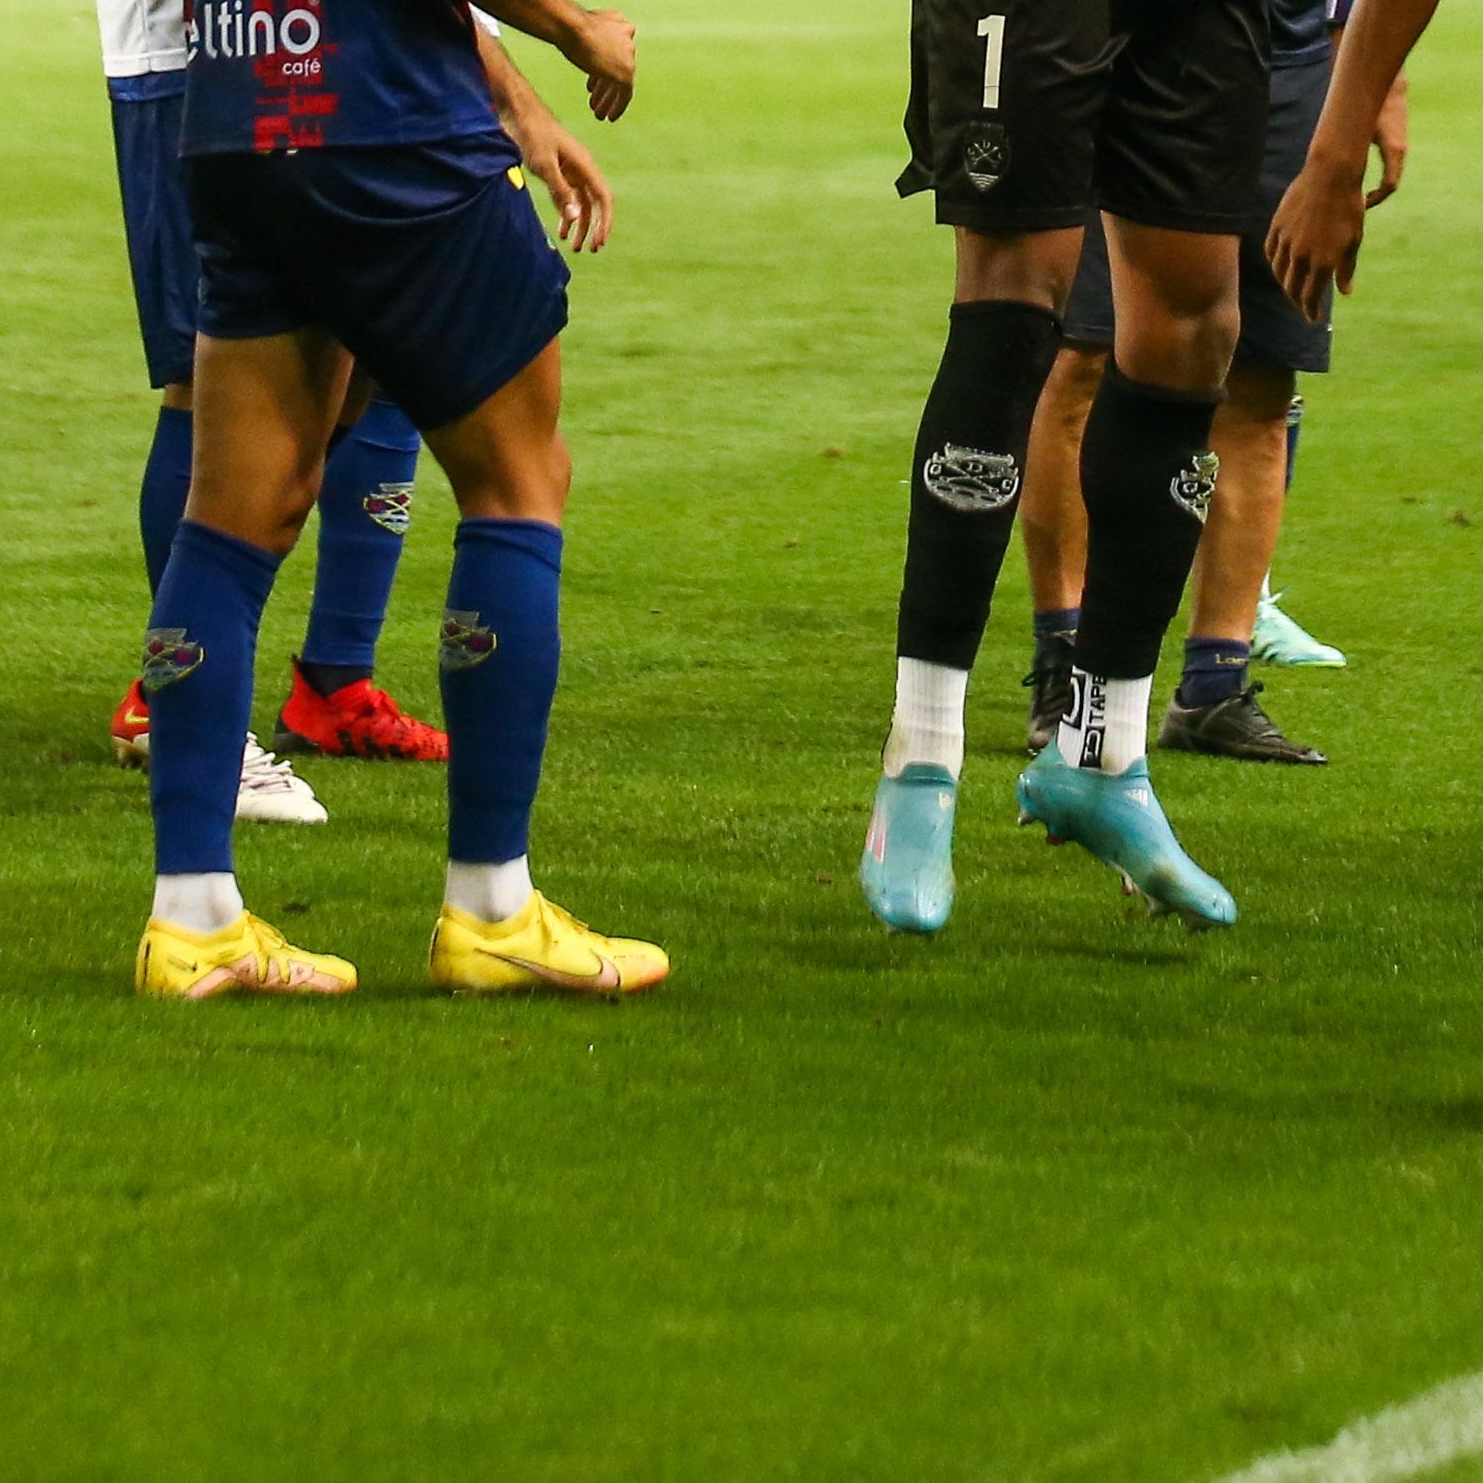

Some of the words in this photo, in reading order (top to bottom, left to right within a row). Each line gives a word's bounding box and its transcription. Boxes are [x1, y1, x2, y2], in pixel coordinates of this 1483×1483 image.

[186, 0, 321, 64] eltino
[976, 14, 1006, 109] 1
[282, 58, 322, 77] café
